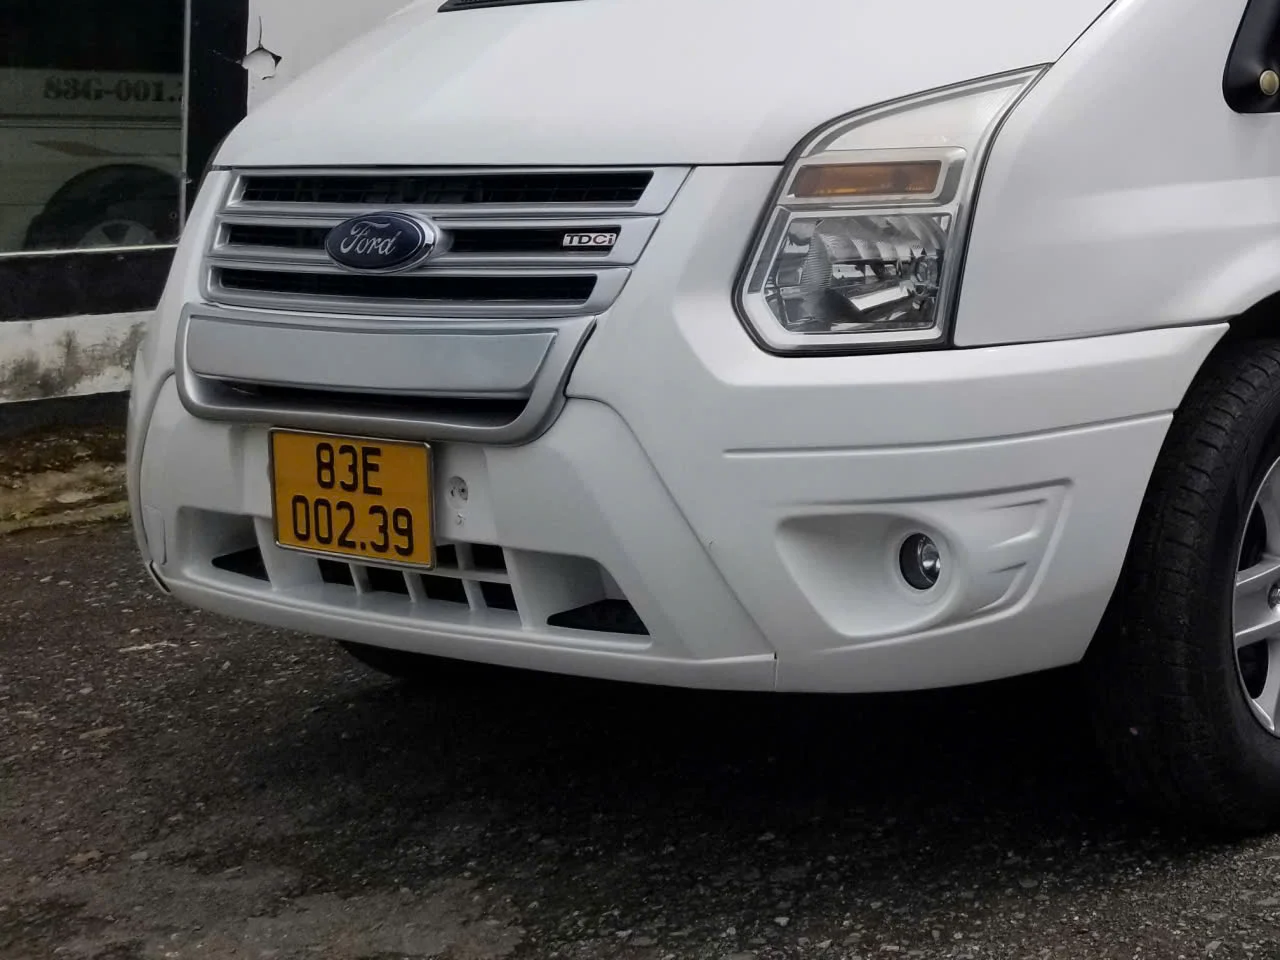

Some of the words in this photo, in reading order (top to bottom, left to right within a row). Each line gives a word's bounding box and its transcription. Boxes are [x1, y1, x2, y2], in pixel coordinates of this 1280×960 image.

[340, 222, 399, 256] Ford
[563, 232, 617, 247] TDCi
[315, 442, 383, 496] 83E
[291, 495, 415, 557] 002.39
